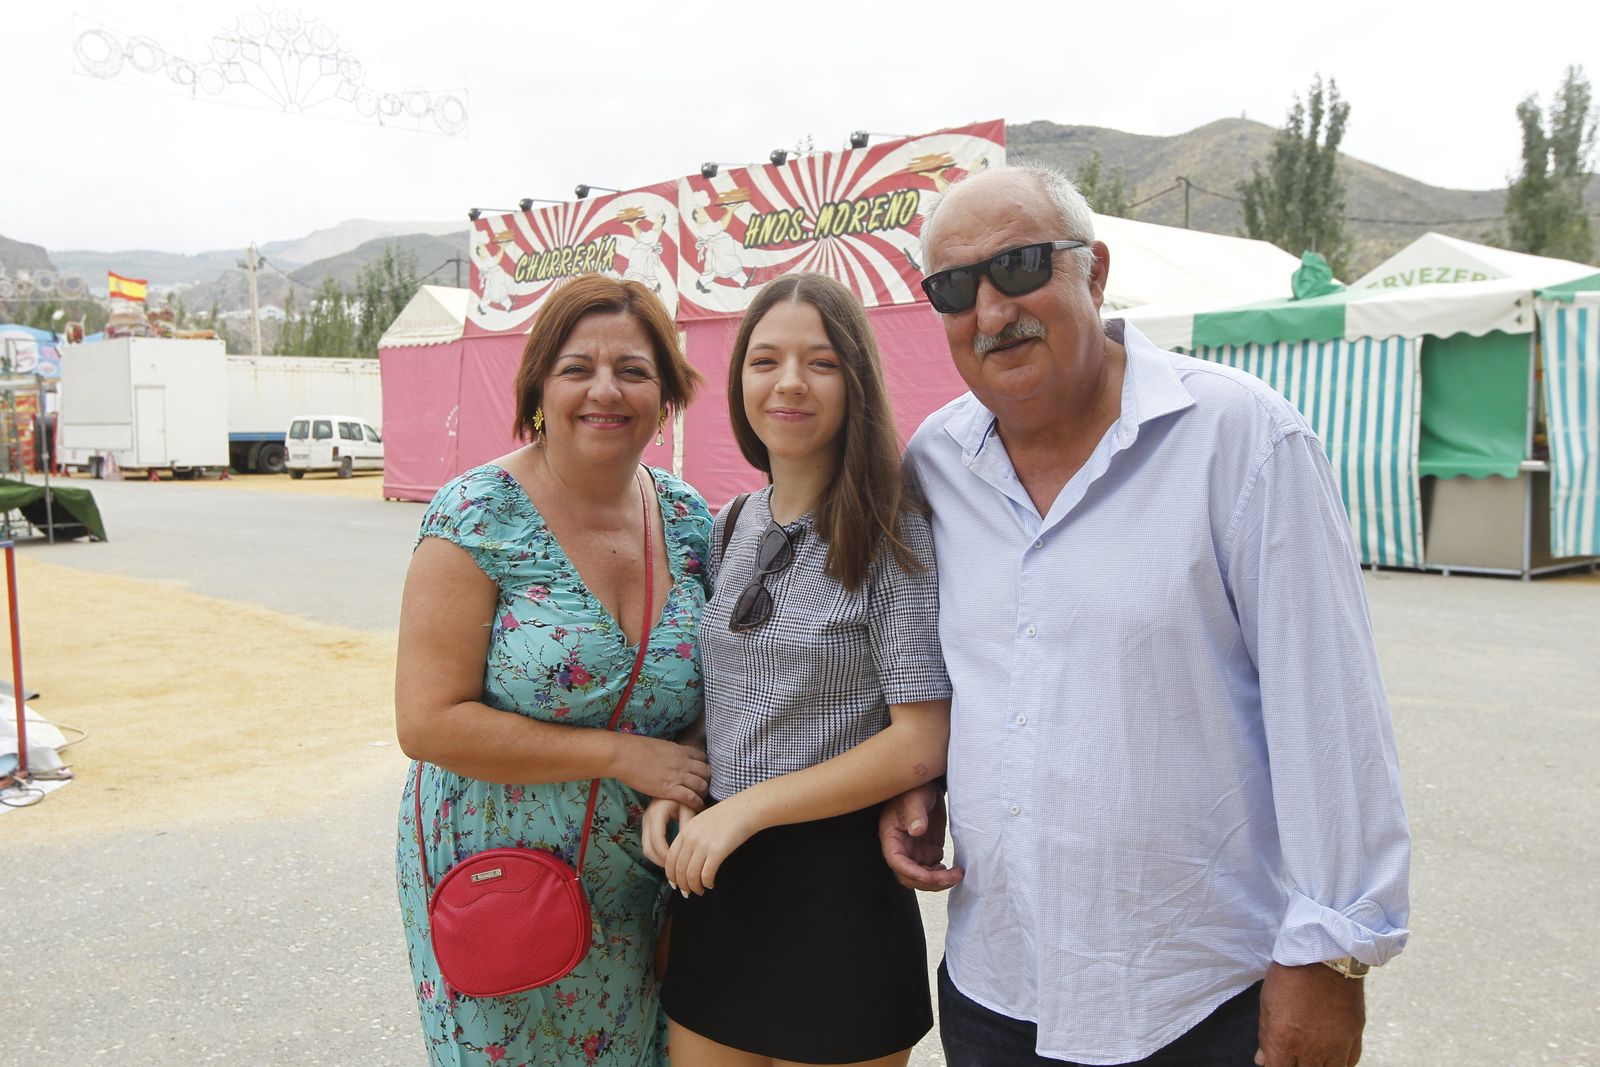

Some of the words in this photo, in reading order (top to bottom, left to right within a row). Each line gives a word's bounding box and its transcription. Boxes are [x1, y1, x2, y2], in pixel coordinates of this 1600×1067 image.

[743, 207, 809, 249] HNOS.
[814, 189, 920, 240] MORENO
[514, 233, 617, 283] CHURRERÍA
